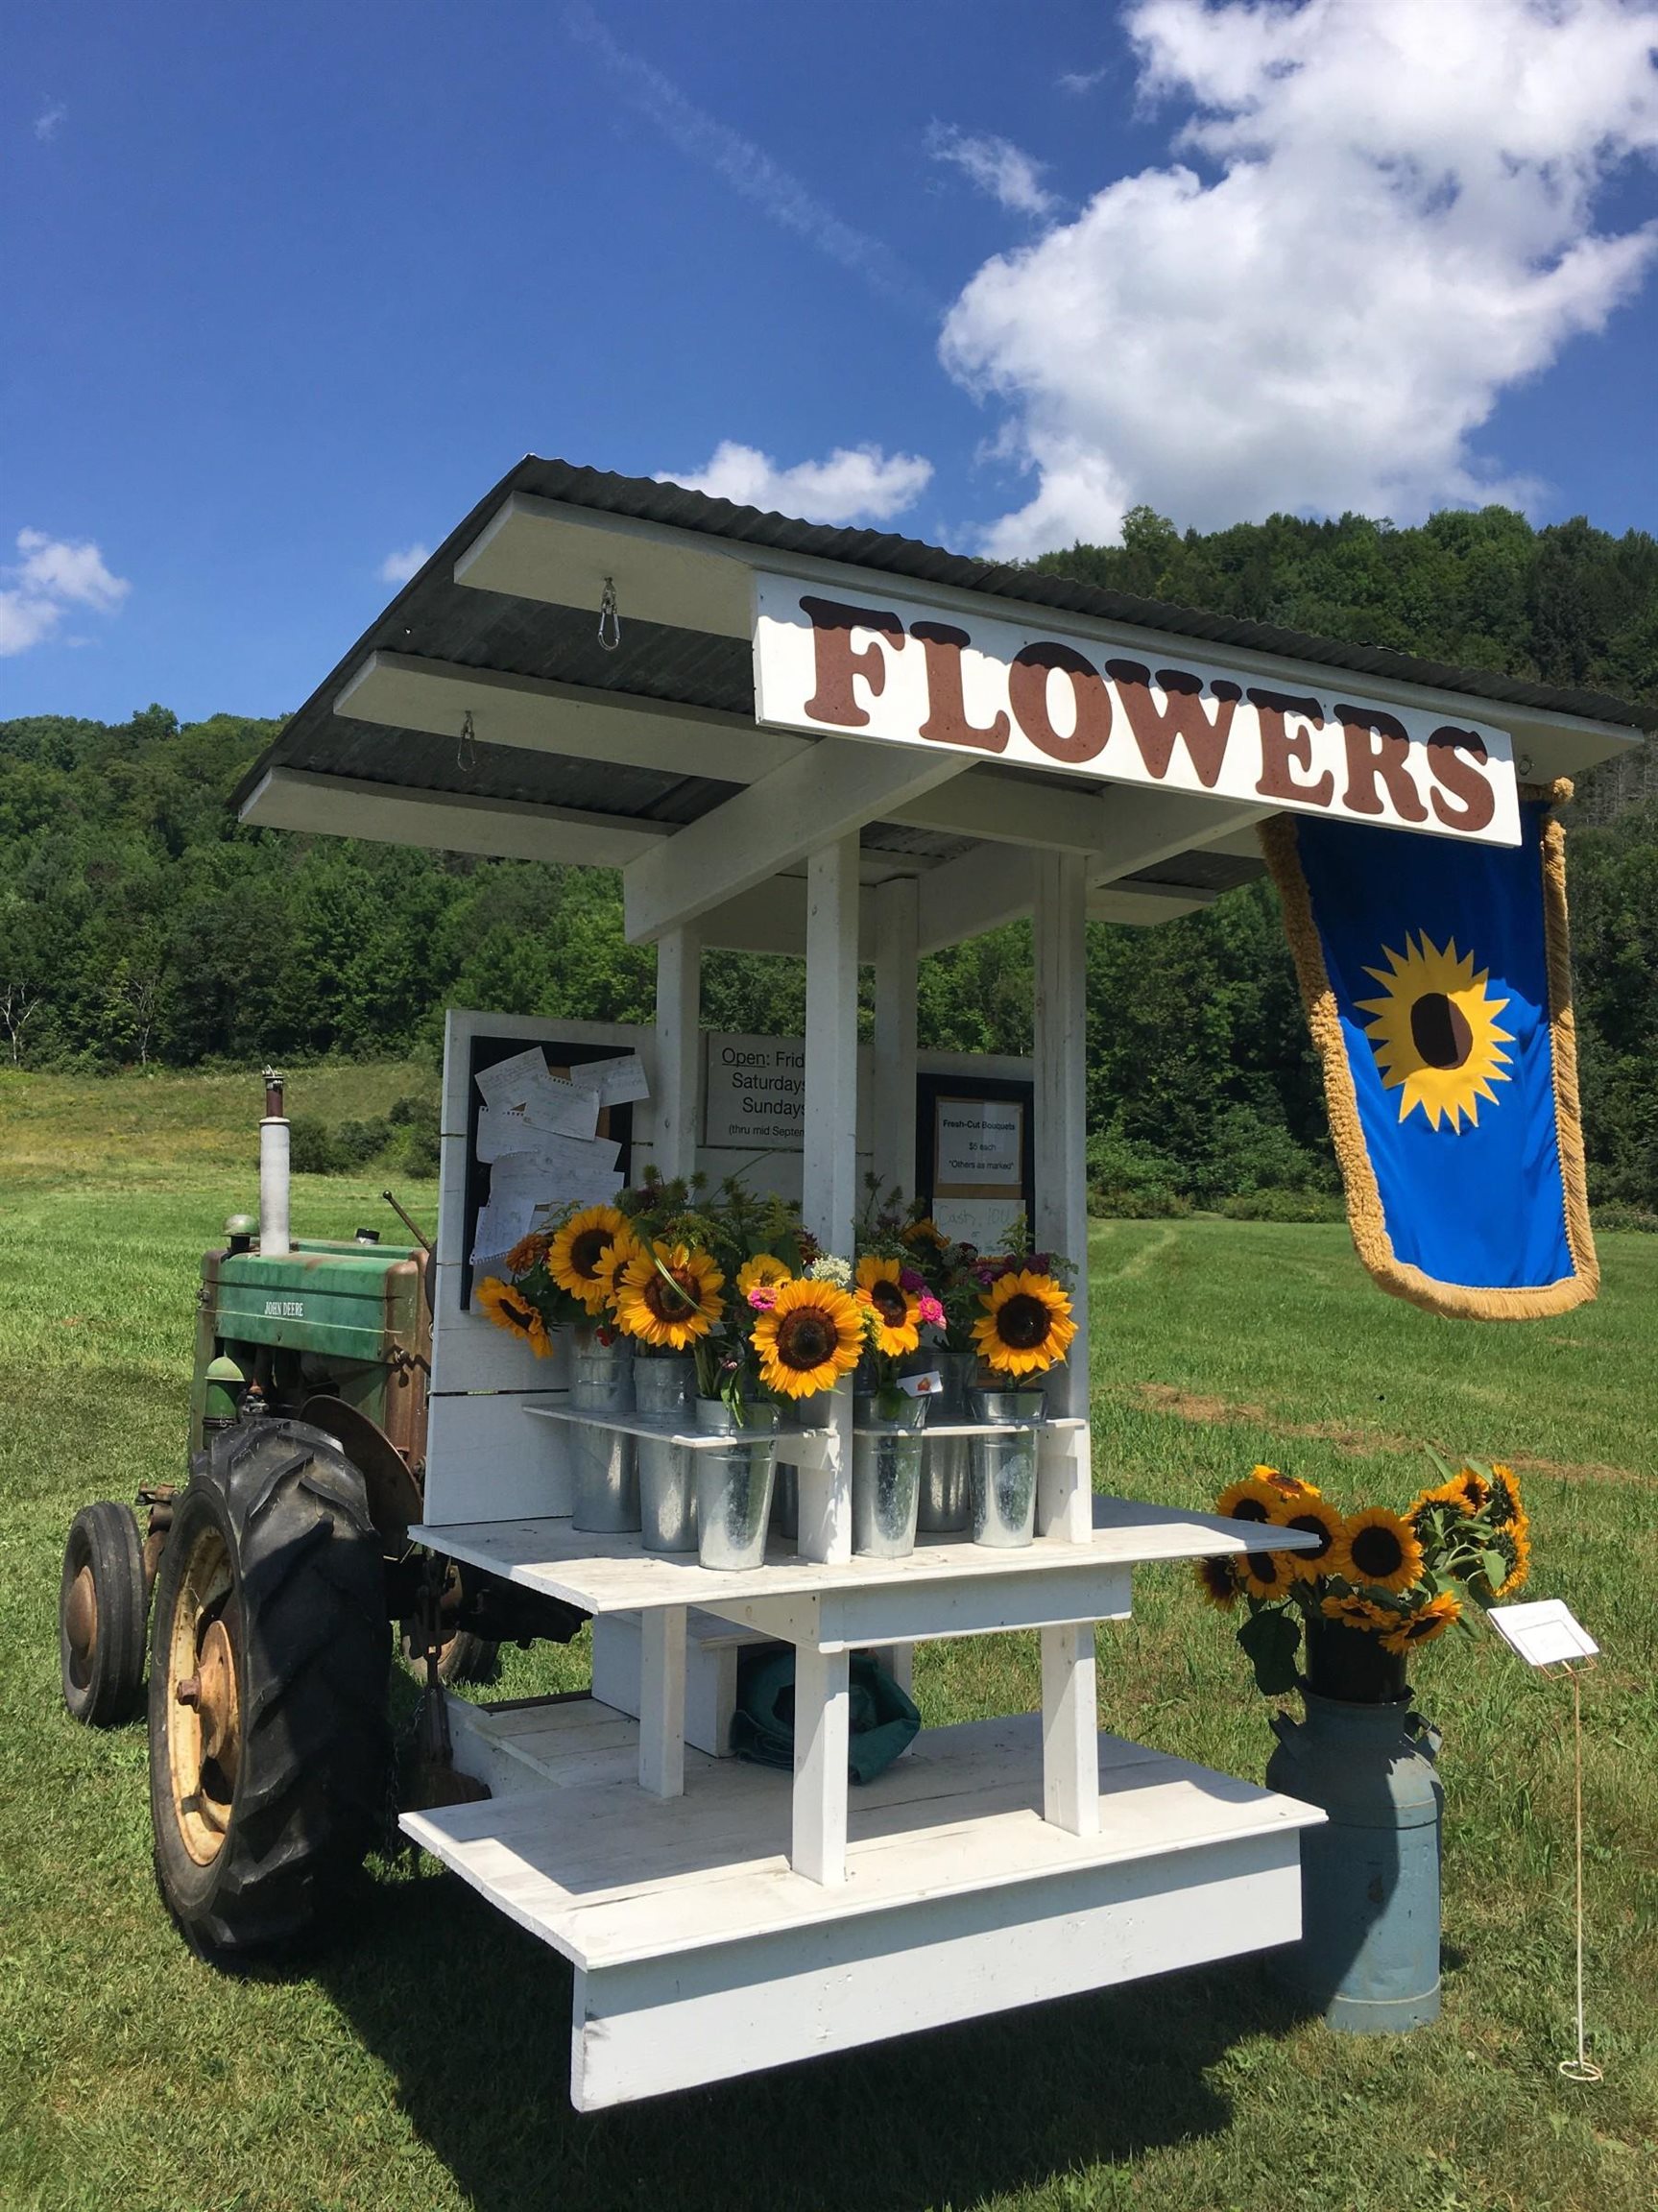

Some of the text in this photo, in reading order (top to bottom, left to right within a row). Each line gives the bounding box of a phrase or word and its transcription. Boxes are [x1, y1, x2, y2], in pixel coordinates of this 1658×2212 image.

[799, 595, 1496, 832] FLOWERS
[722, 1047, 770, 1068] Open:
[730, 1122, 750, 1136] (thru
[753, 1126, 770, 1136] mid
[943, 1119, 1016, 1131] Fresh-Cut Bouquets
[265, 1301, 304, 1316] JOHN DEERE
